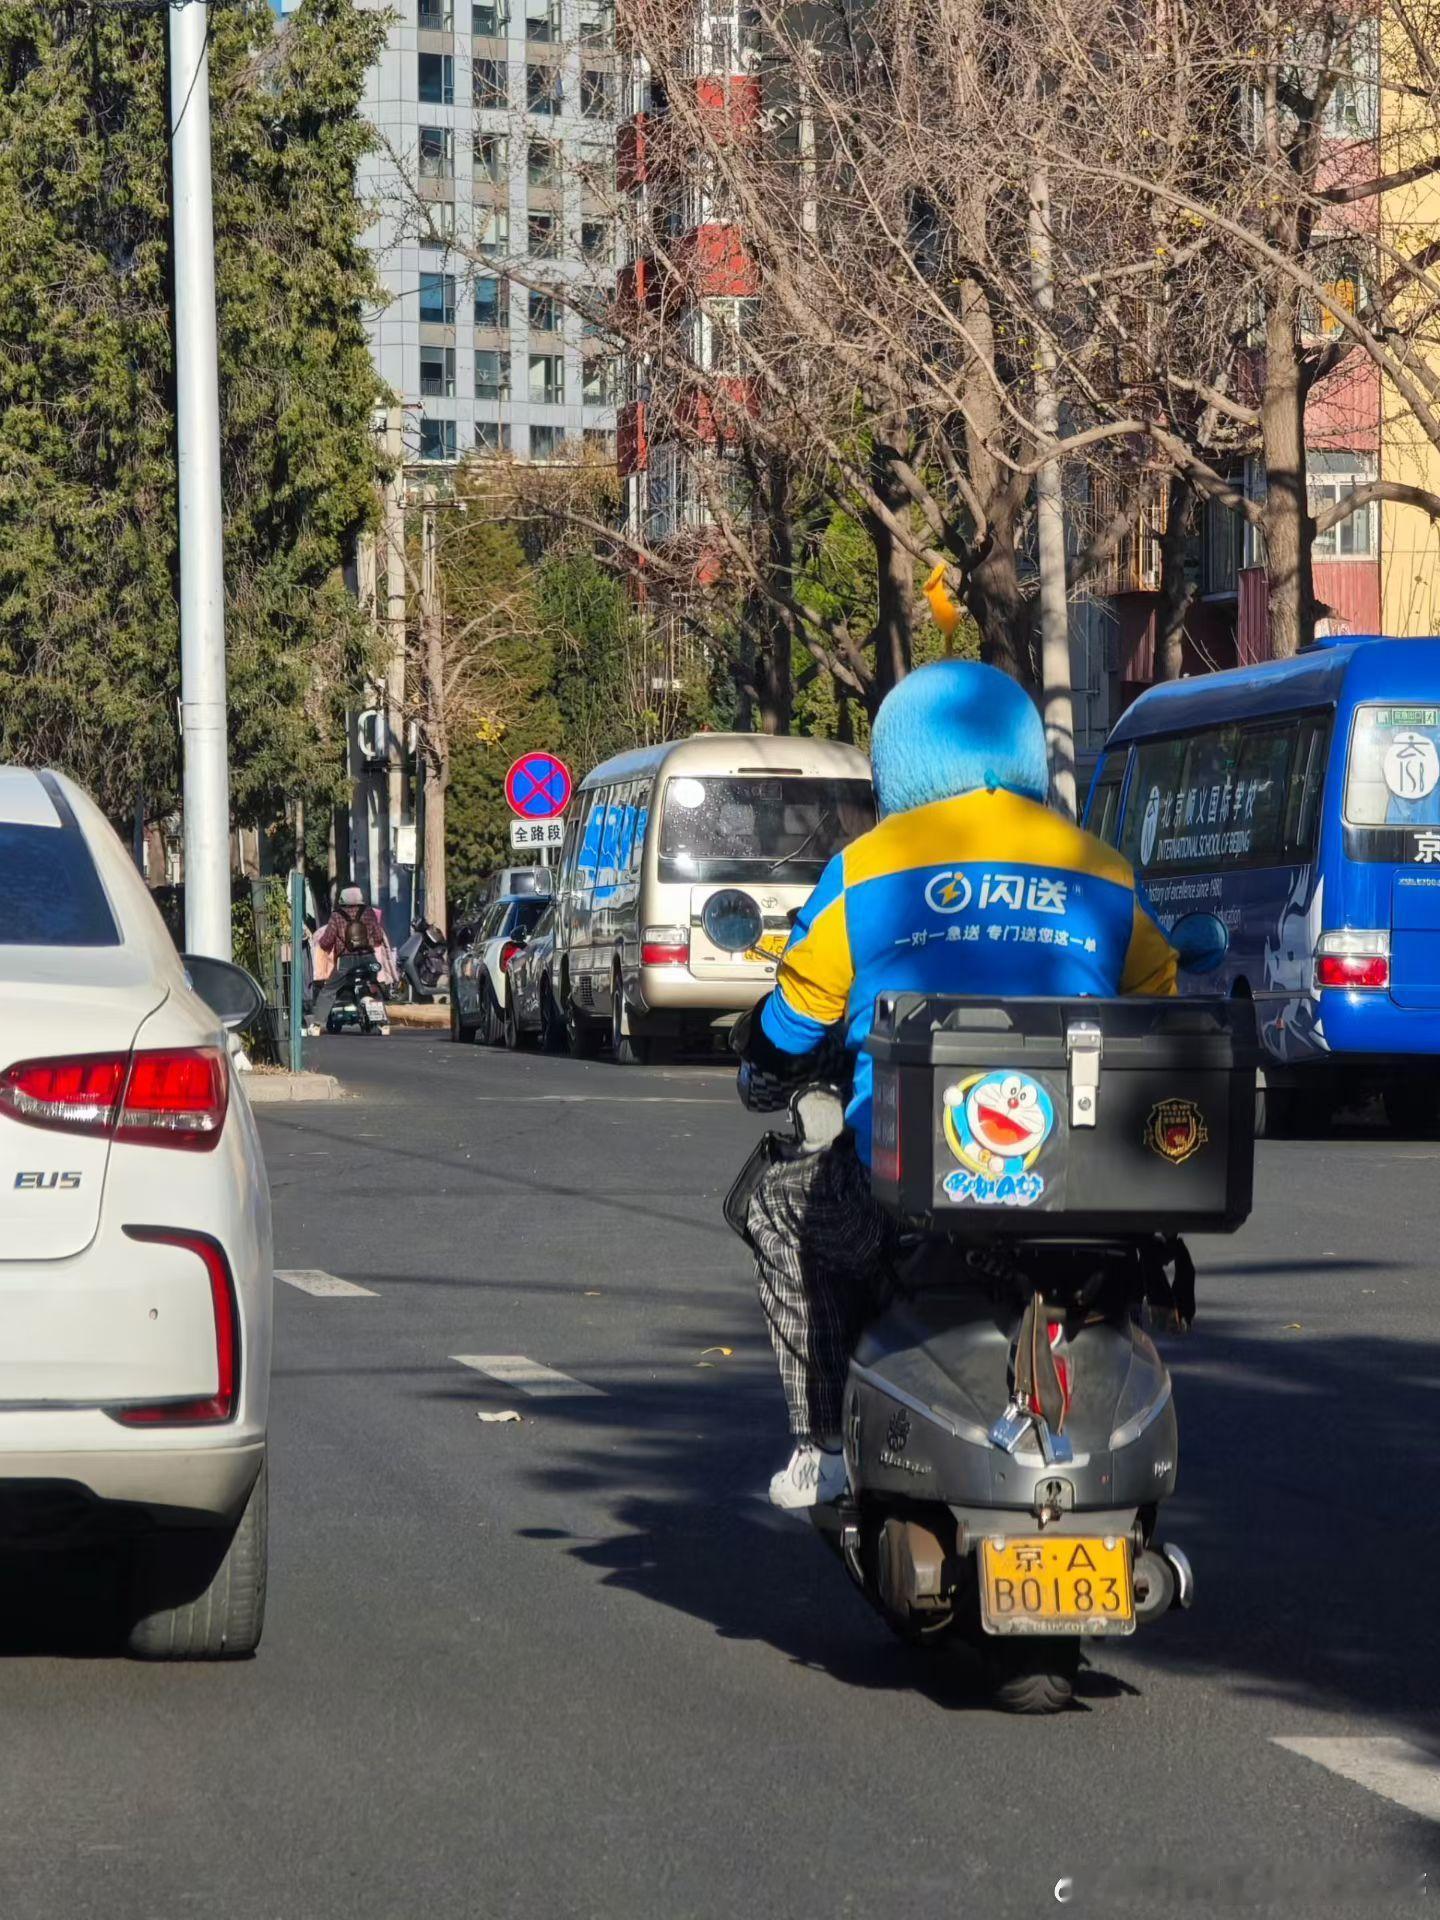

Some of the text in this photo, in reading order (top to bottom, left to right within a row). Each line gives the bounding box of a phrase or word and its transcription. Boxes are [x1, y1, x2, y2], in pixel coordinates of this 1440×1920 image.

[1161, 779, 1257, 828] 北京顺义国际学校
[515, 825, 560, 842] 全路段
[1157, 835, 1199, 860] INTERNATIONAL
[1199, 833, 1221, 857] SCHOOL
[1221, 832, 1230, 854] OF
[1414, 832, 1440, 863] 京
[978, 874, 1067, 915] 闪送
[1171, 881, 1196, 899] excellence
[1195, 880, 1210, 898] since
[895, 925, 1097, 952] 一对一急送 专门送您这一单
[994, 1577, 1120, 1613] B0183
